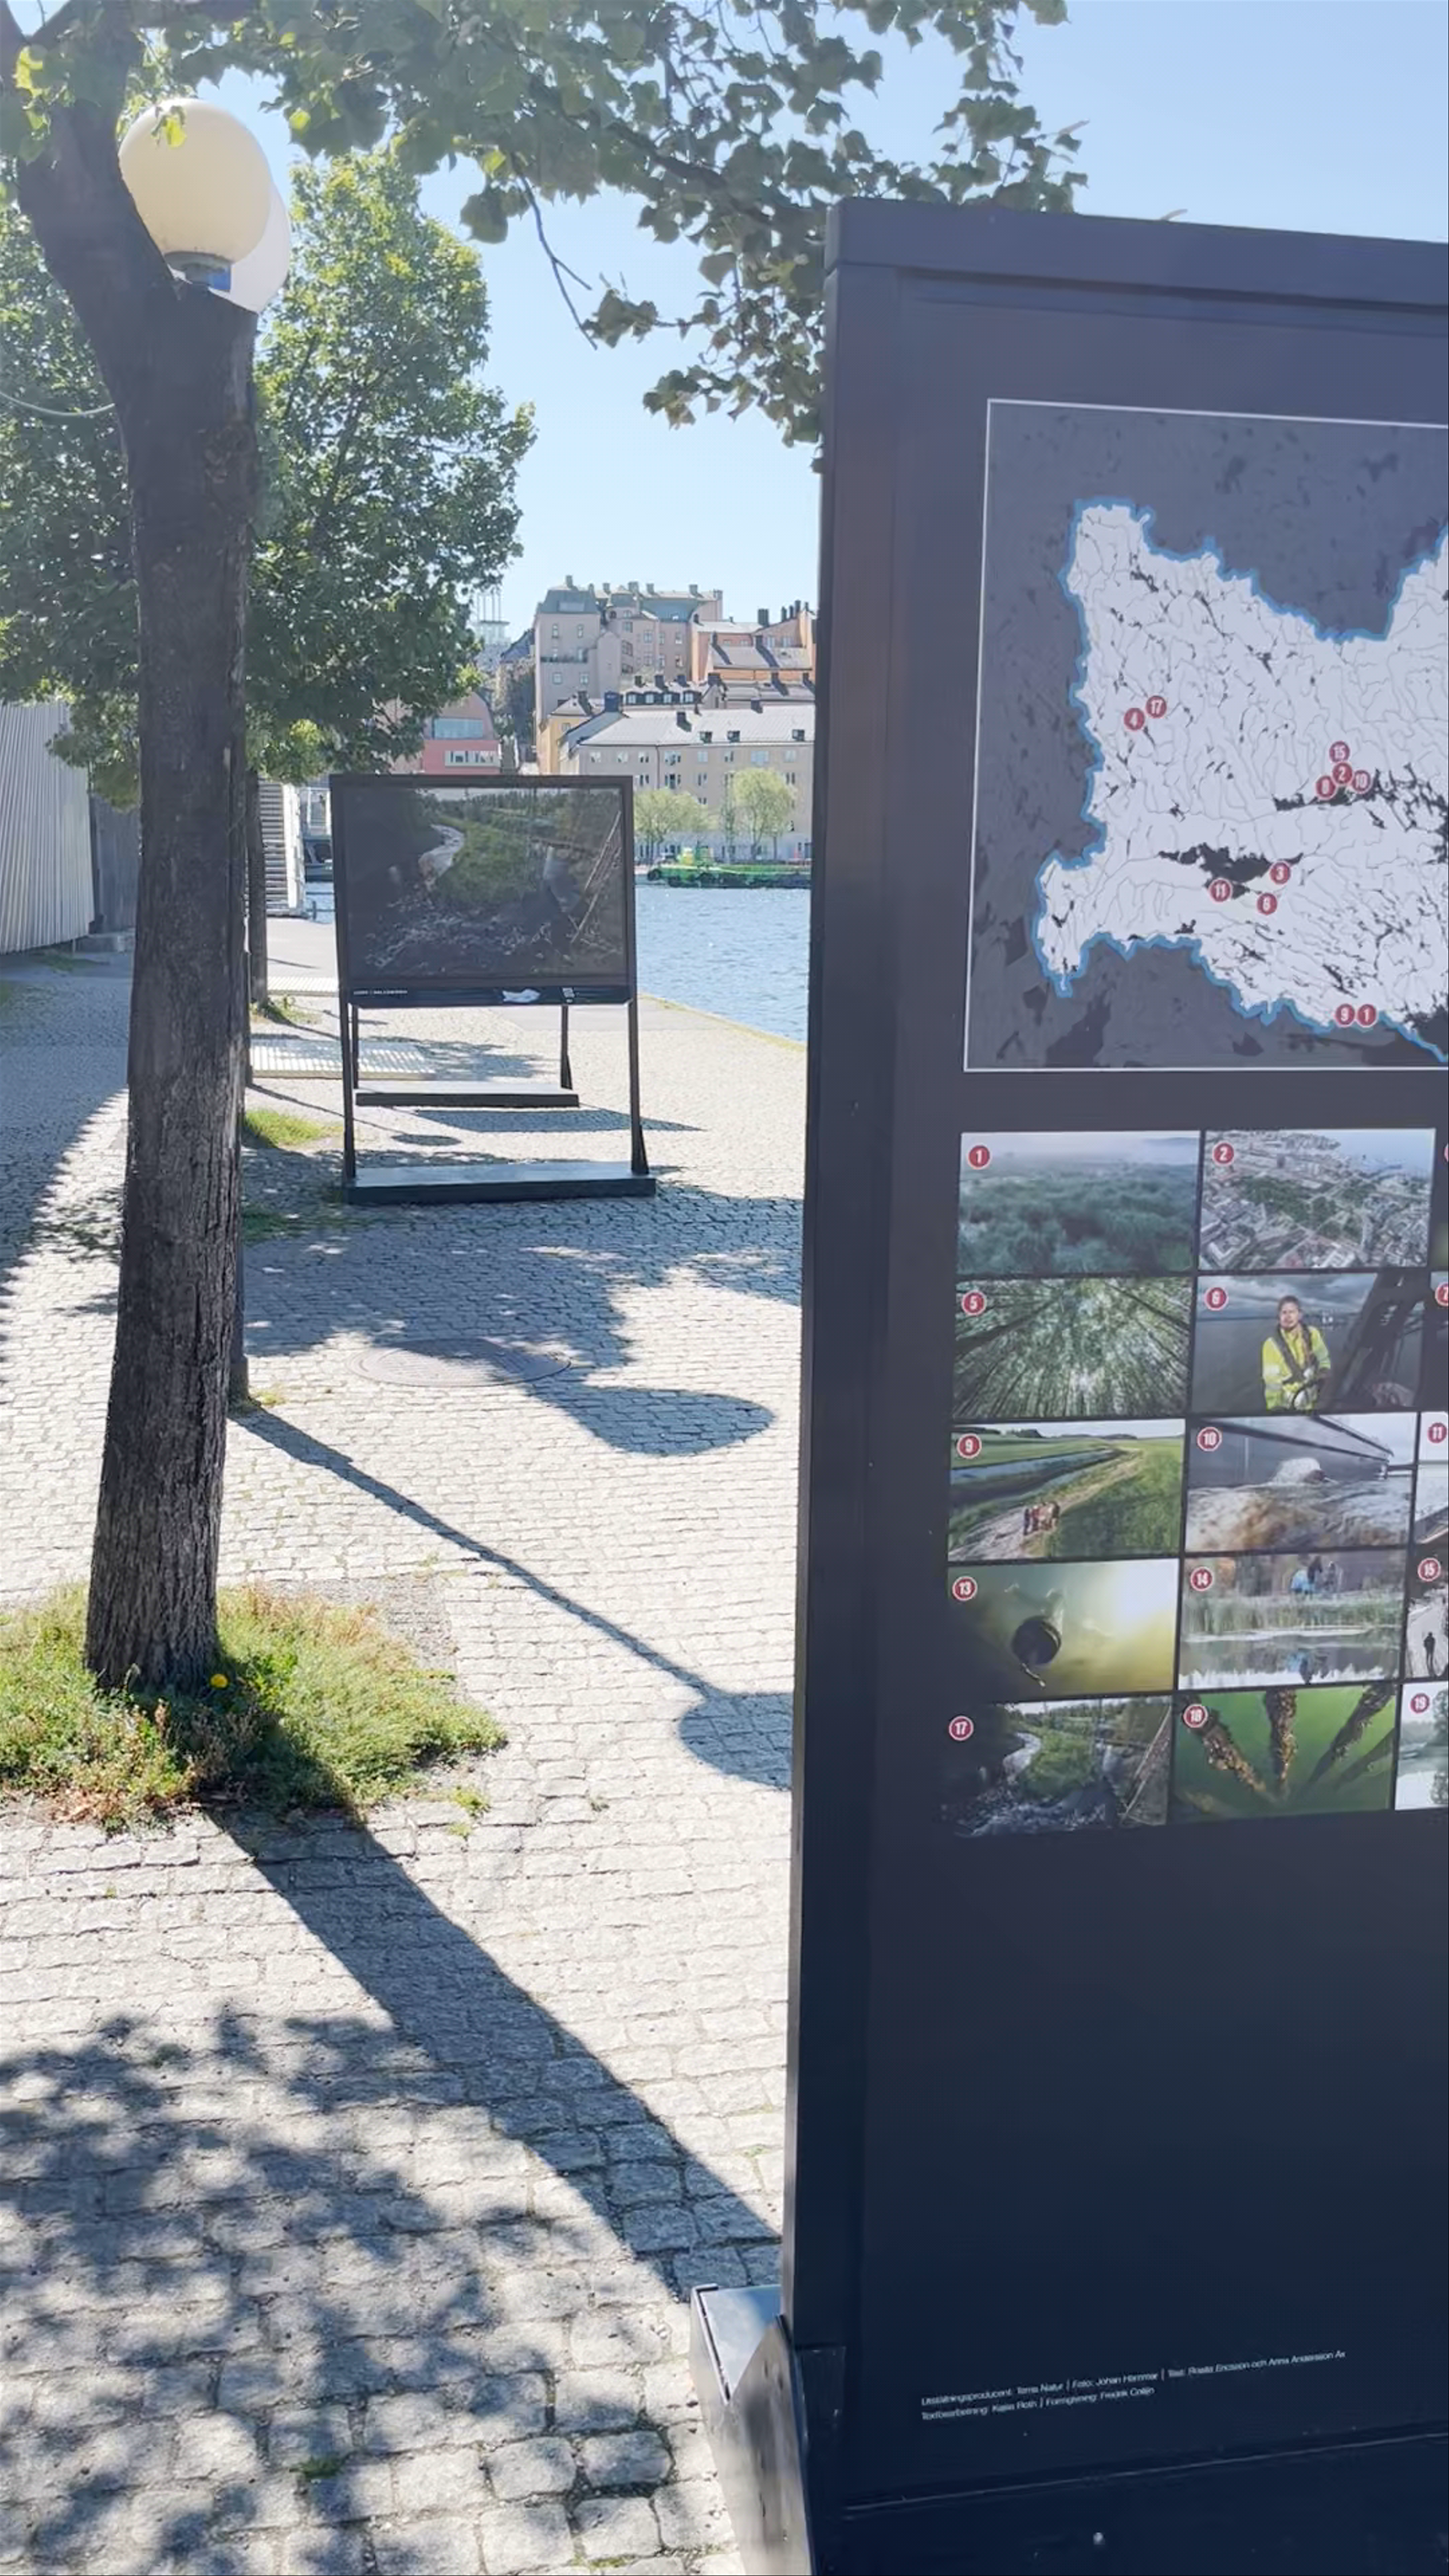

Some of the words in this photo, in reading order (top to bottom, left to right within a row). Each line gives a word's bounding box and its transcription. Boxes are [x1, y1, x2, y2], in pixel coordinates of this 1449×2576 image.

[1151, 700, 1163, 714] 17
[1130, 713, 1137, 726] 4
[1334, 746, 1345, 759] 15
[1339, 766, 1346, 781] 2
[1356, 774, 1367, 788] 10
[1277, 866, 1284, 880] 3
[1215, 884, 1226, 897] 11
[1341, 1007, 1348, 1021] 9
[1364, 1009, 1369, 1021] 1
[977, 1150, 981, 1163] 1
[1220, 1147, 1227, 1160] 2
[970, 1296, 977, 1310] 5
[1204, 1432, 1216, 1445] 10
[1433, 1427, 1442, 1439] 11
[966, 1439, 973, 1452] 9
[1425, 1563, 1435, 1575] 15
[1197, 1573, 1208, 1585] 14
[960, 1582, 971, 1595] 13
[1415, 1697, 1426, 1709] 19
[955, 1722, 967, 1735] 17
[1096, 2377, 1121, 2386] Johan
